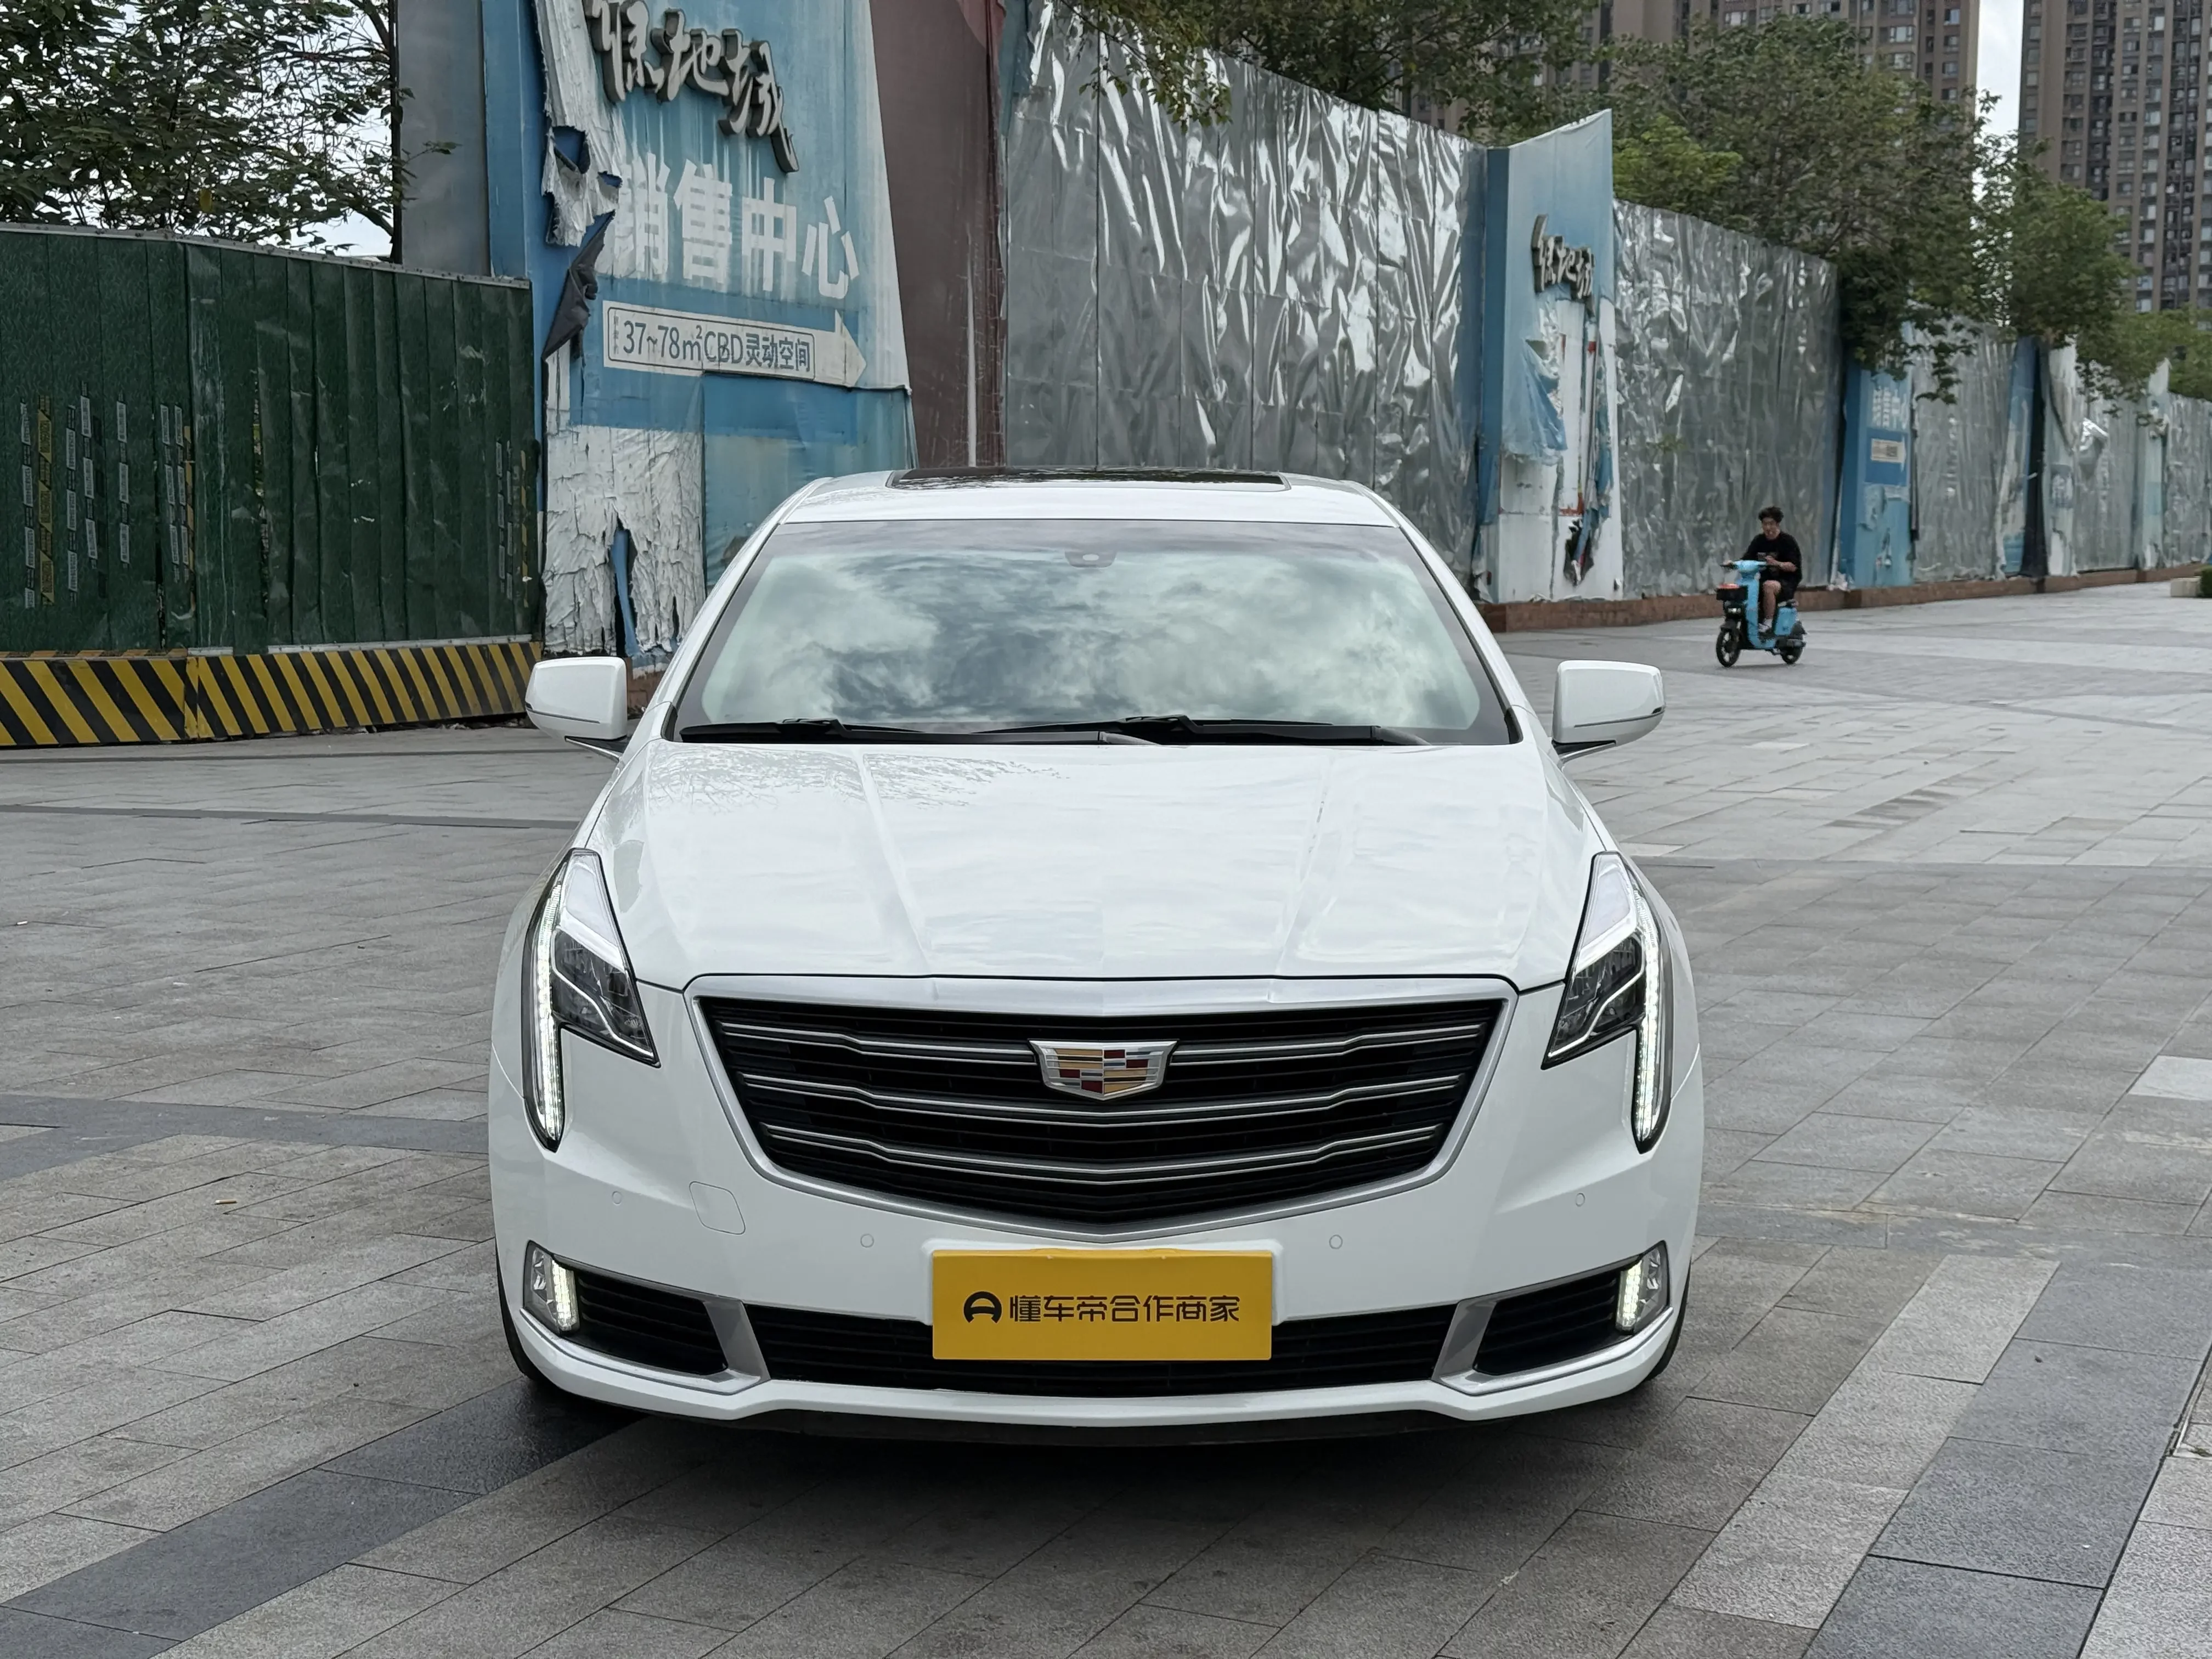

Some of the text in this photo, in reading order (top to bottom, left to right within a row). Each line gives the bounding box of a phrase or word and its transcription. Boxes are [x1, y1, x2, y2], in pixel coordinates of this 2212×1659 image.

[610, 151, 860, 299] 销售中心
[1009, 1295, 1240, 1322] 懂车帝合作商家
